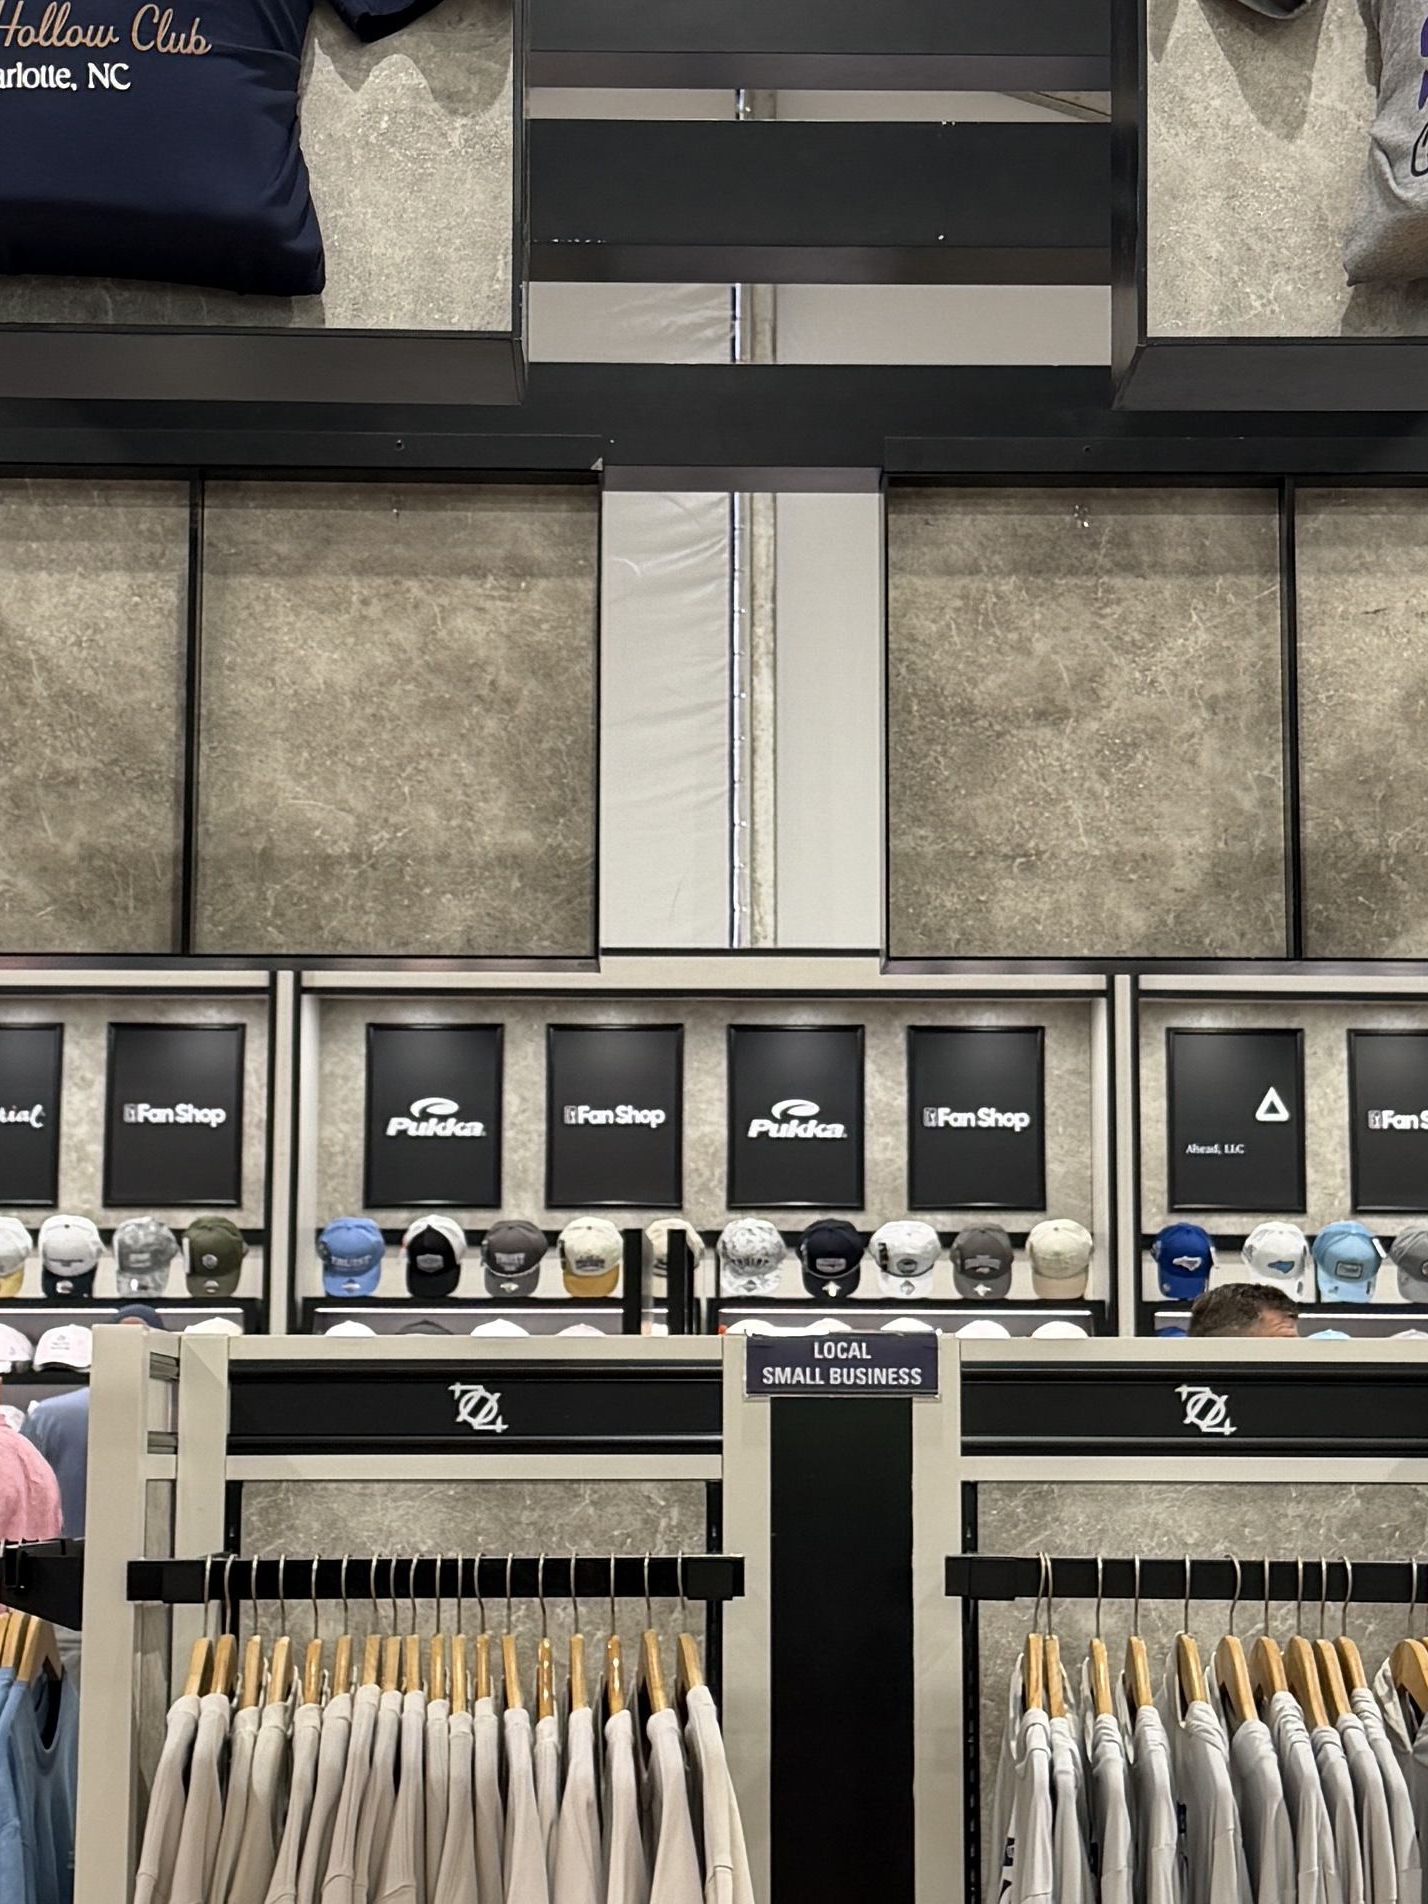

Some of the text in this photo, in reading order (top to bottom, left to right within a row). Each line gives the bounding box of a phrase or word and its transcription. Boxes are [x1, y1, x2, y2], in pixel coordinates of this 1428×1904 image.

[131, 3, 213, 57] Club
[87, 63, 132, 90] NC
[137, 1103, 227, 1128] Fan Shop
[576, 1104, 666, 1128] Fan Shop
[937, 1106, 1031, 1132] Fan Shop
[1382, 1110, 1419, 1130] Fan
[386, 1117, 486, 1137] Pukka
[747, 1119, 848, 1139] Pukka
[1185, 1143, 1245, 1156] Ahead, LLC
[814, 1341, 872, 1359] LOCAL
[762, 1366, 923, 1386] SMALL BUSINESS
